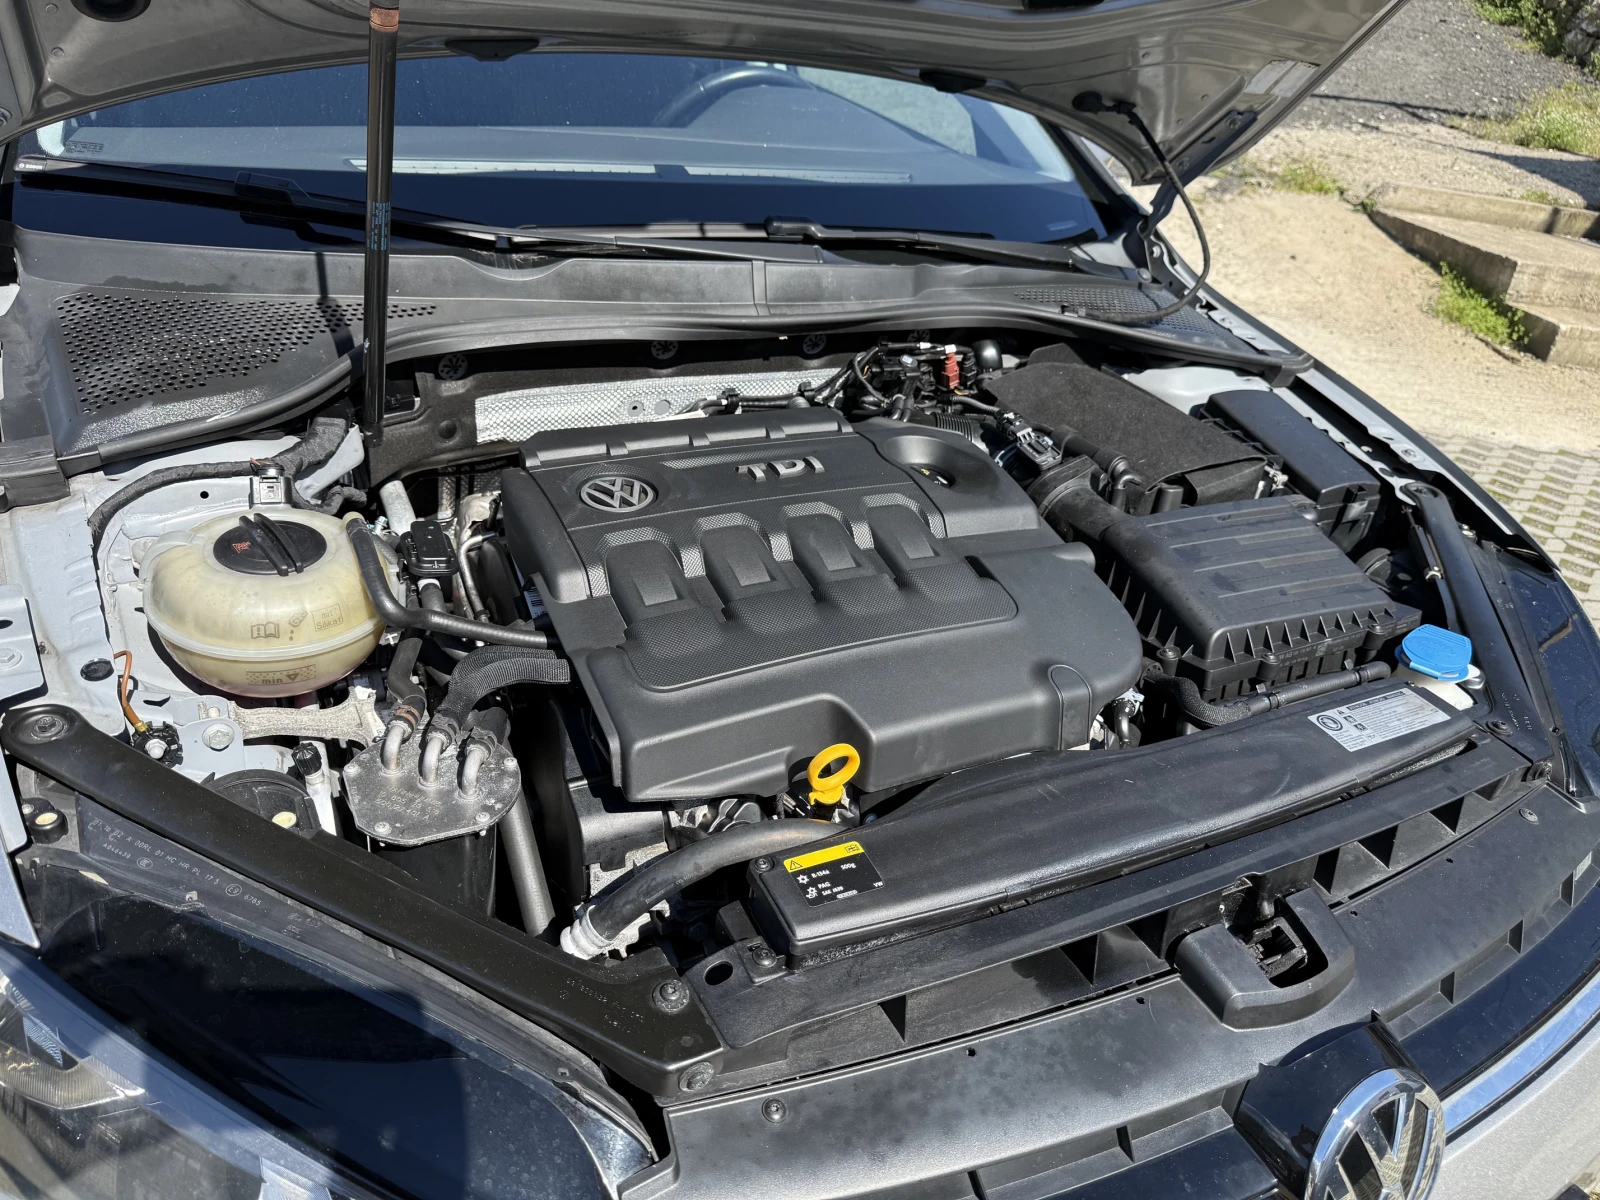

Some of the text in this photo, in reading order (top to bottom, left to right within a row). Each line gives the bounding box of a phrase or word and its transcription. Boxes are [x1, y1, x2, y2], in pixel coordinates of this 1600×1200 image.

[735, 455, 826, 482] TDI
[261, 677, 283, 685] min
[178, 861, 190, 870] HR
[191, 867, 201, 876] PL
[817, 881, 831, 889] PAG
